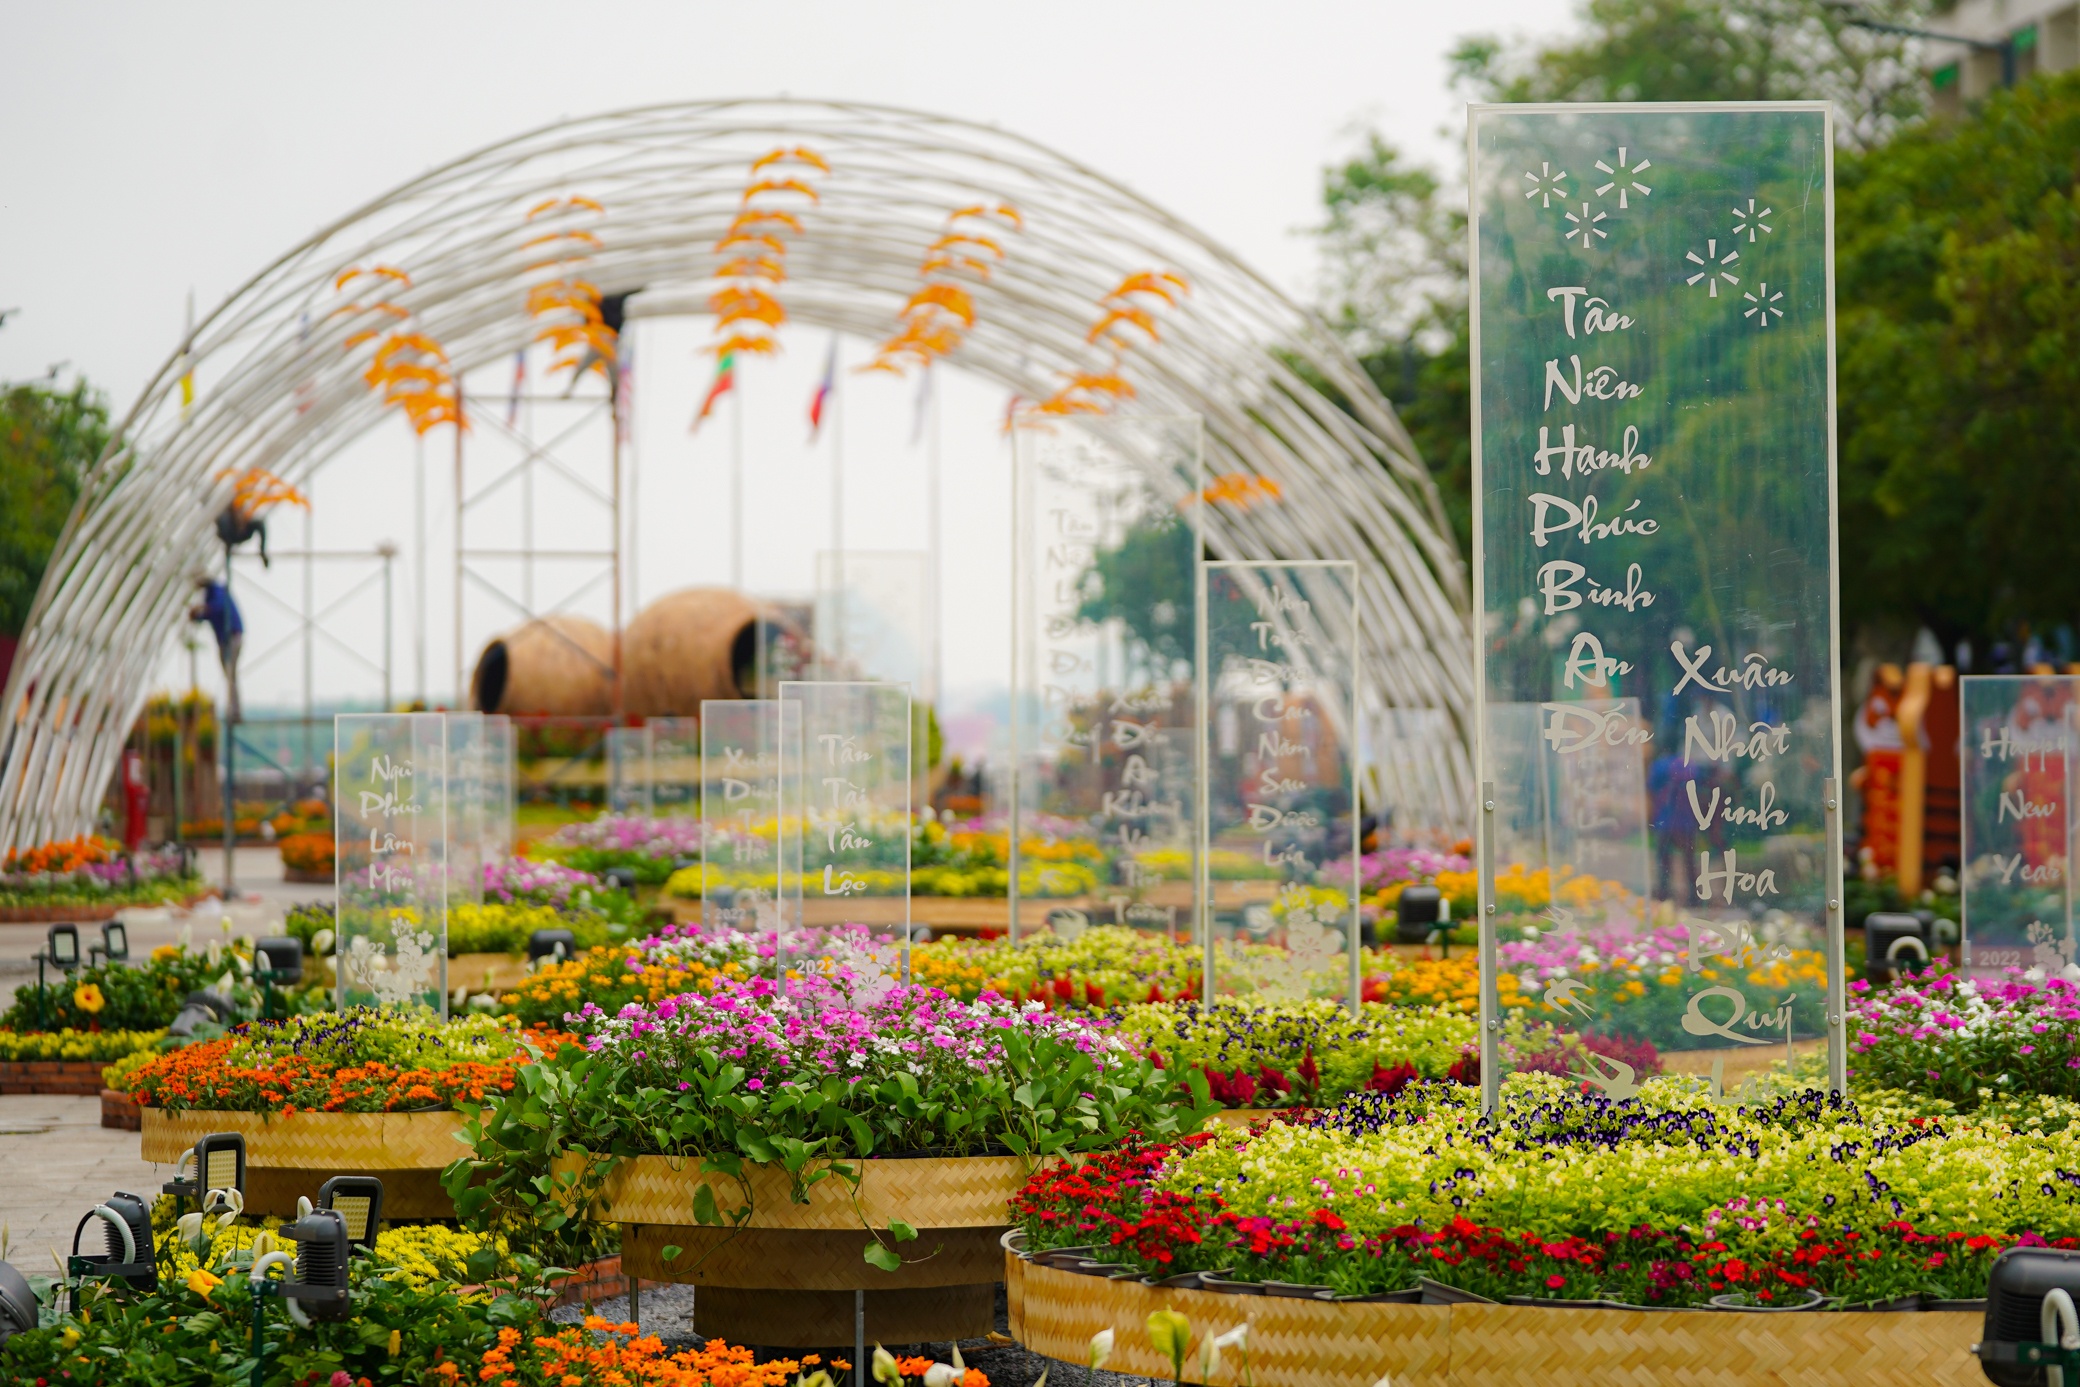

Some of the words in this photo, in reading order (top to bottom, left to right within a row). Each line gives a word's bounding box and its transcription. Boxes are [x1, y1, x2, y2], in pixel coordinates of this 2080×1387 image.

[1547, 286, 1635, 339] Tân
[1544, 355, 1644, 411] Niên
[1534, 424, 1652, 480] Hạnh
[1528, 493, 1660, 547] Phúc
[1537, 560, 1656, 615] Bình
[1563, 632, 1634, 689] An
[1670, 640, 1794, 695] Xuân
[818, 733, 873, 767] Tấn
[1258, 730, 1310, 760] Năm
[1541, 702, 1654, 754] Đến
[1683, 710, 1791, 767] Nhật
[1981, 726, 2069, 773] Happy
[371, 754, 415, 803] Ngũ
[822, 777, 867, 809] Tài
[1260, 767, 1307, 794] Sau
[358, 790, 423, 819] Phúc
[1686, 780, 1789, 830] Vinh
[1999, 788, 2056, 824] New
[370, 827, 415, 856] Lâm
[817, 821, 873, 853] Tấn
[824, 864, 868, 896] Lộc
[1695, 848, 1779, 905] Hoa
[1993, 853, 2062, 885] Year
[351, 942, 386, 955] 22
[795, 959, 837, 975] 2022
[1682, 917, 1793, 972] Phú
[1980, 951, 2021, 967] 2022
[1681, 986, 1797, 1071] Quý
[1711, 1056, 1776, 1105] Lai
